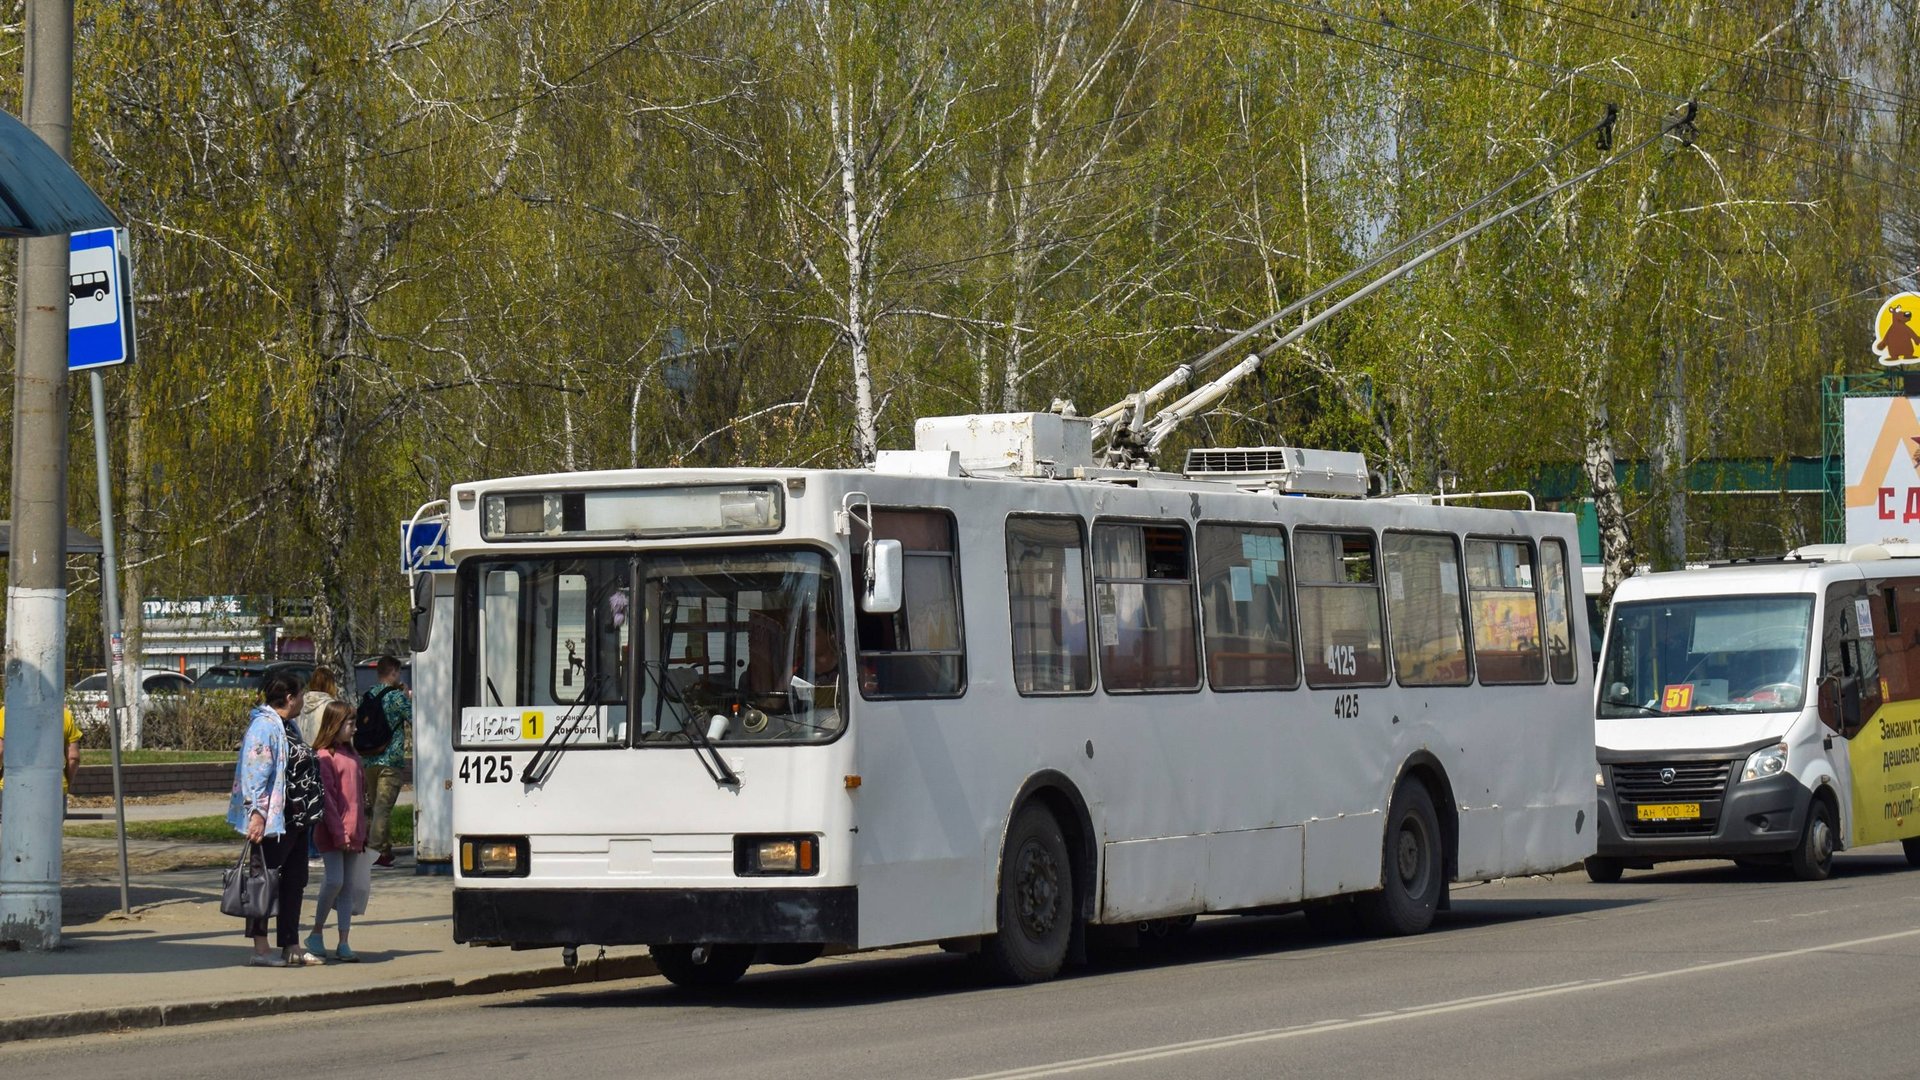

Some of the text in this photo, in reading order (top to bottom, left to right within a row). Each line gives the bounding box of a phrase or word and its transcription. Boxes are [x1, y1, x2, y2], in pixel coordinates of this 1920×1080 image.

[1328, 645, 1356, 676] 4125
[1334, 693, 1359, 719] 4125
[1666, 688, 1689, 708] 51
[461, 714, 521, 742] 4125
[528, 715, 537, 735] 1
[574, 725, 597, 735] быта
[1879, 718, 1912, 741] Закажи
[458, 755, 513, 784] 4125
[1884, 745, 1920, 773] дешевле
[1643, 804, 1696, 817] АН 100 22
